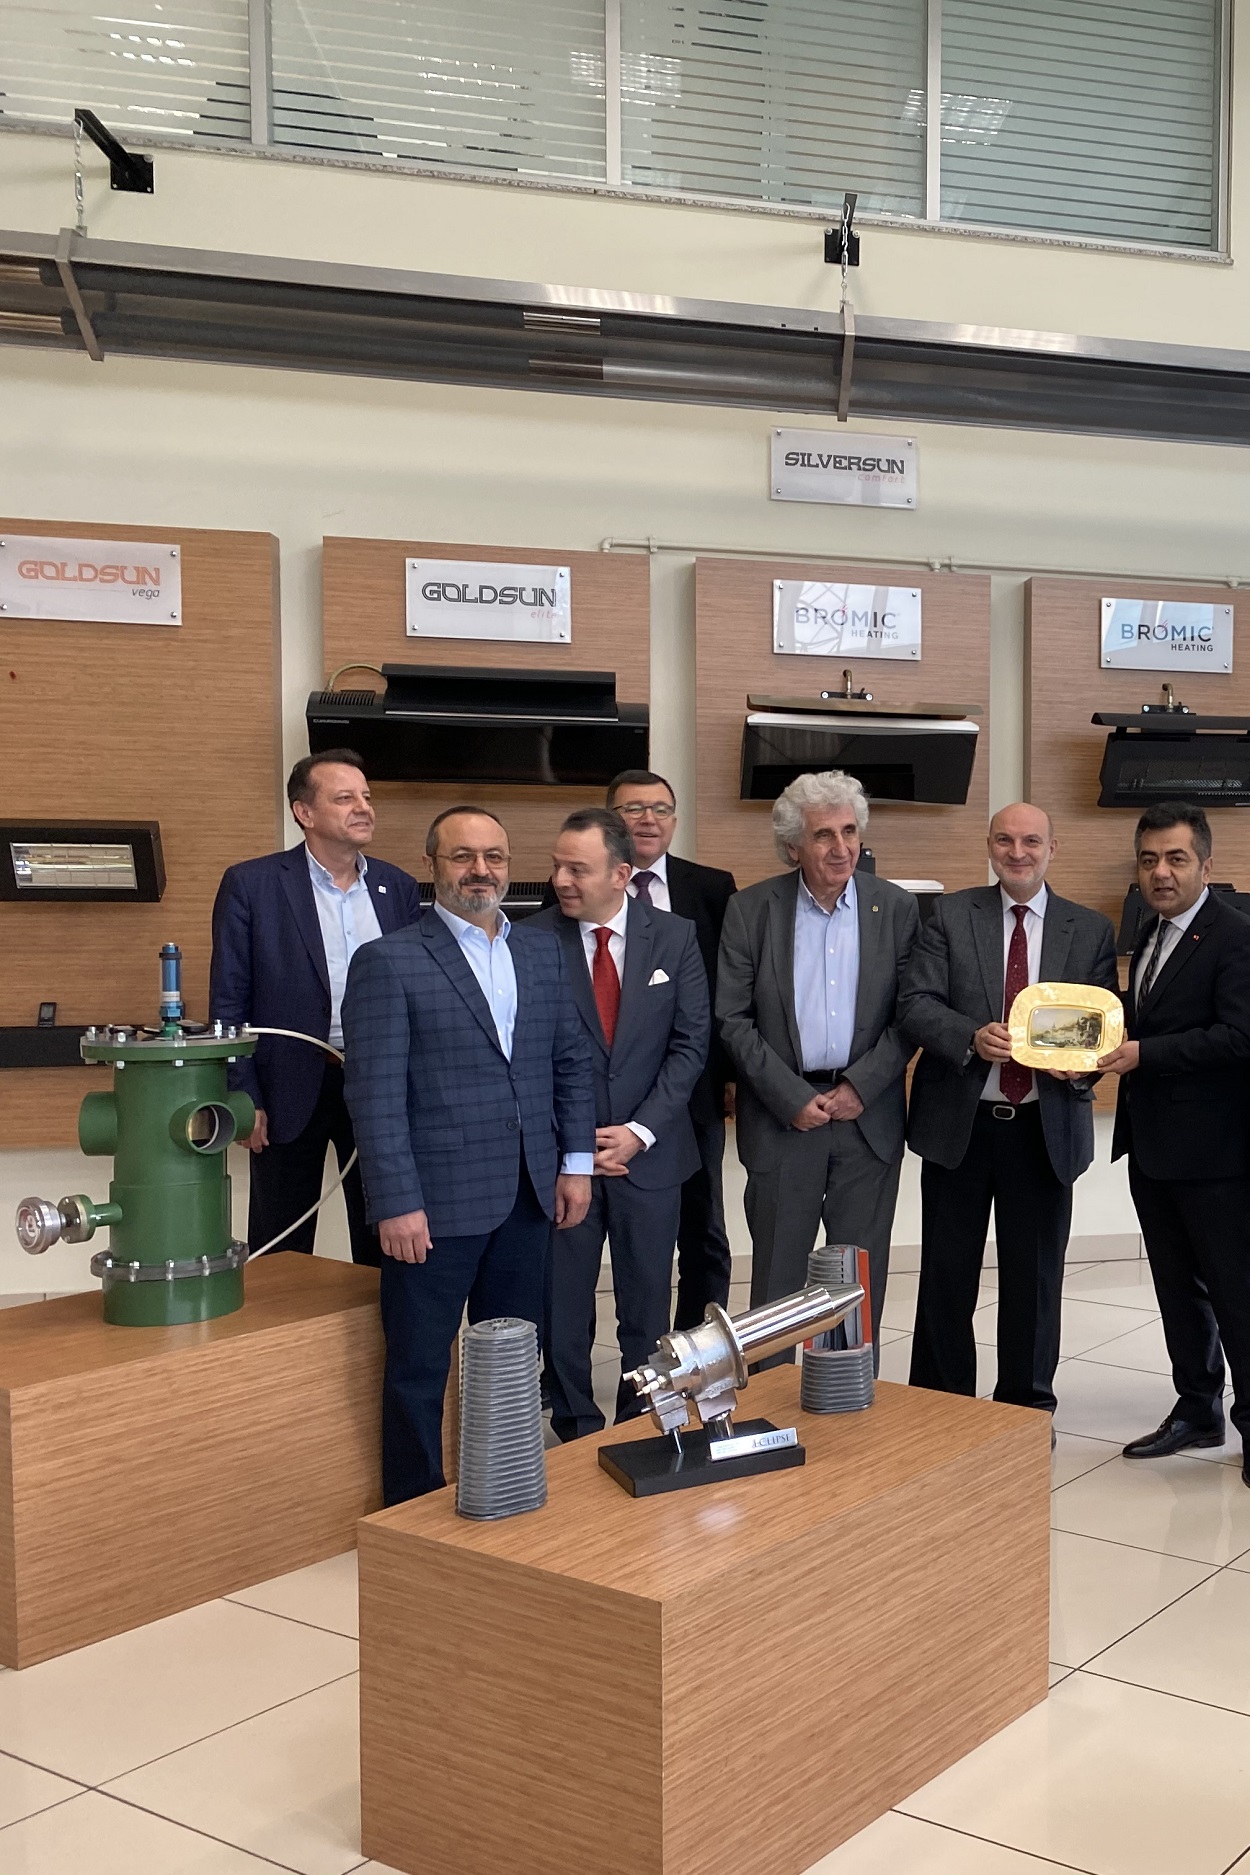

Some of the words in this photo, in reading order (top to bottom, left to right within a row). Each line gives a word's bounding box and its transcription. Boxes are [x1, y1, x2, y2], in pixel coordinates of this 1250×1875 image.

[785, 452, 905, 474] SILVERSUN
[18, 560, 161, 586] GOLDSUN
[132, 588, 160, 600] vega
[422, 582, 557, 607] GOLDSUN
[795, 607, 897, 629] BROMIC
[851, 629, 899, 639] HEATING
[1121, 623, 1212, 642] BROMIC
[1171, 643, 1214, 652] HEATING
